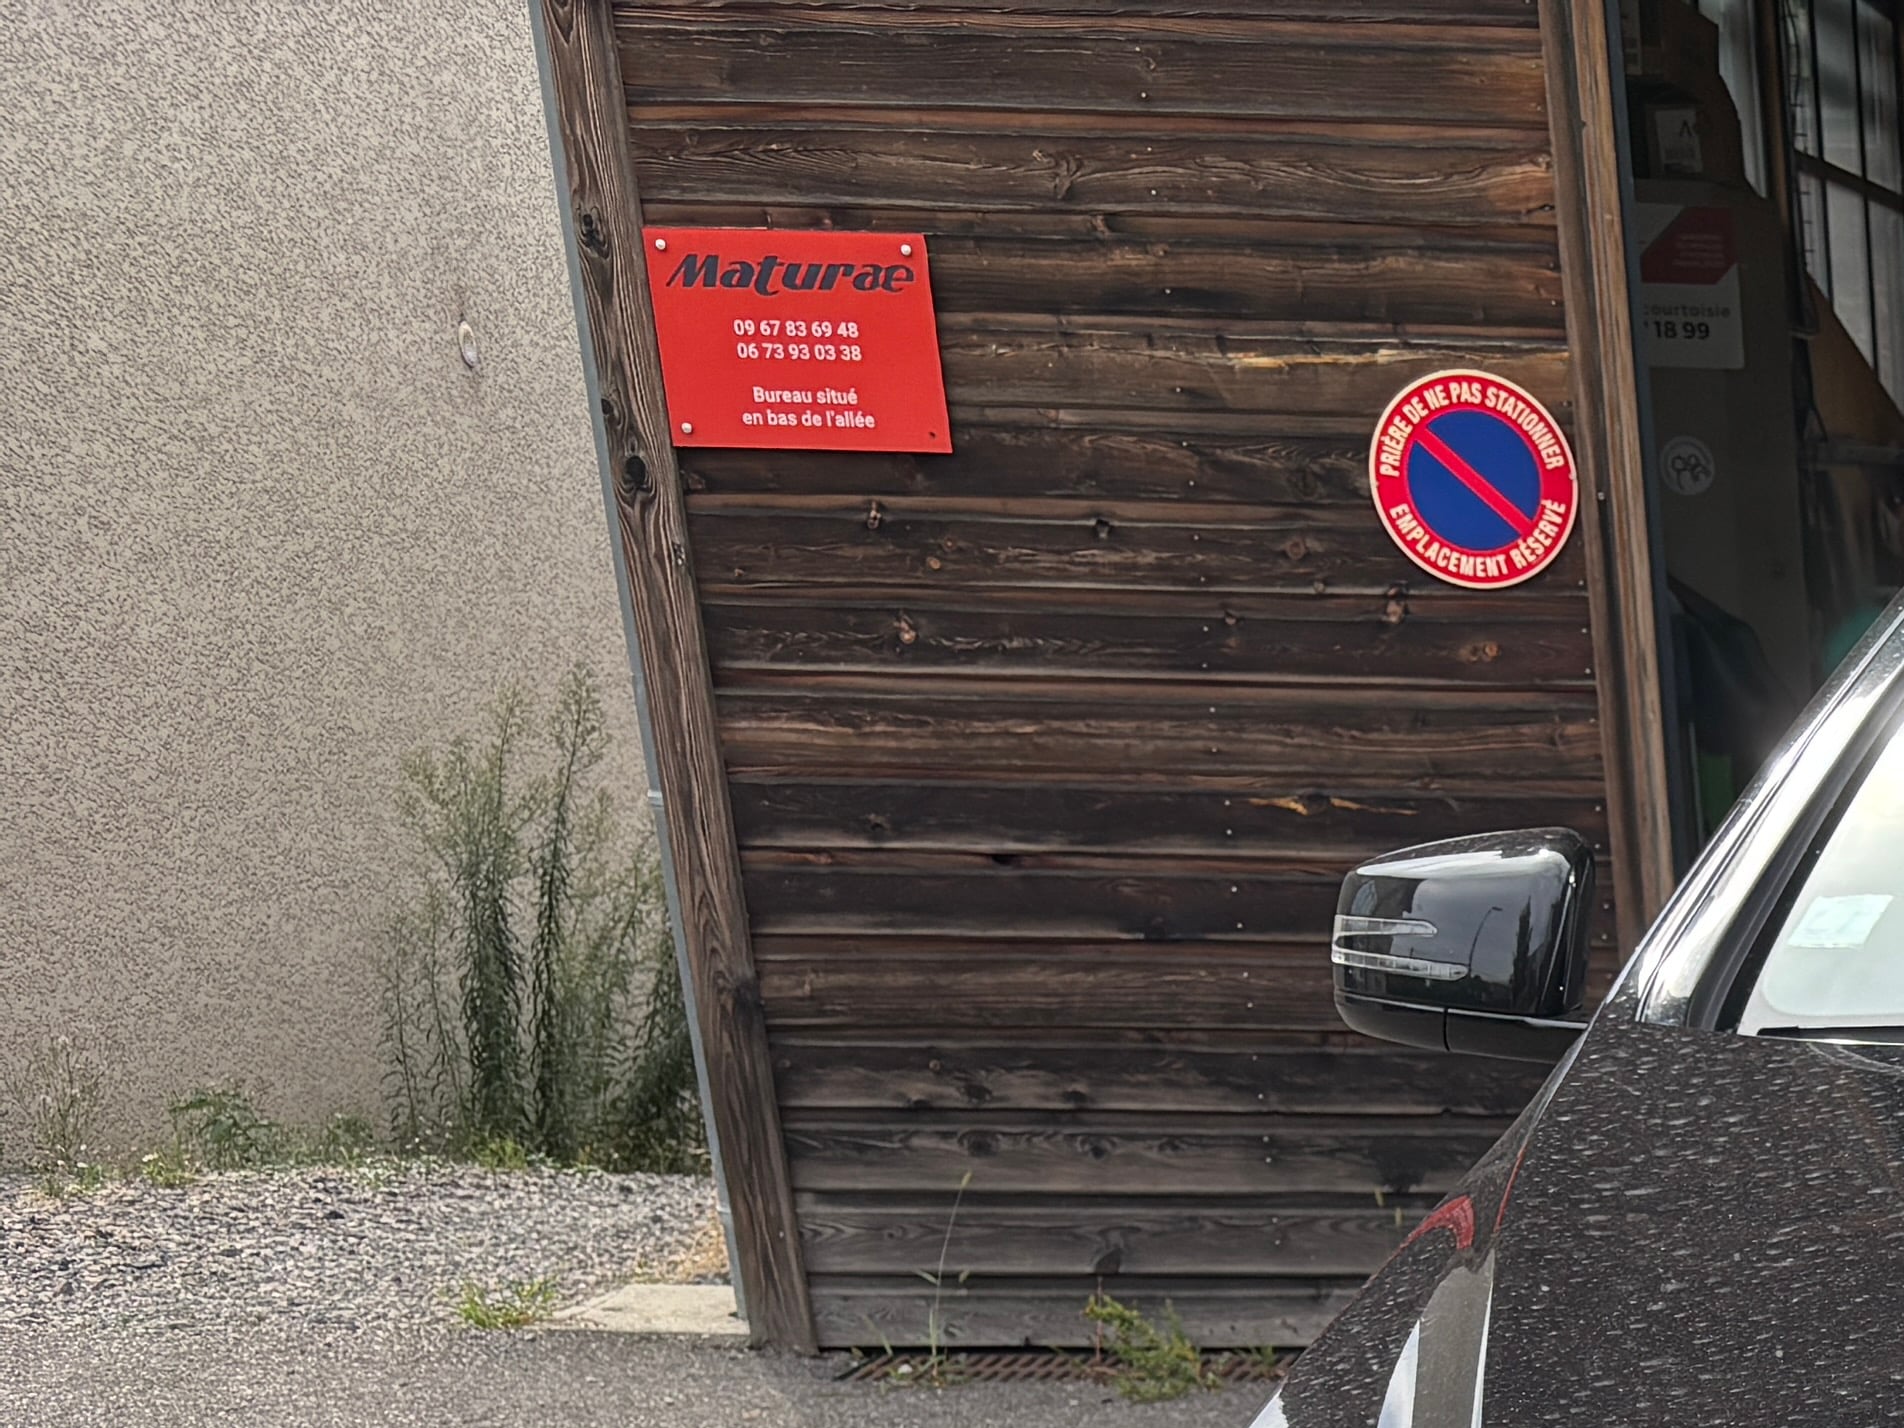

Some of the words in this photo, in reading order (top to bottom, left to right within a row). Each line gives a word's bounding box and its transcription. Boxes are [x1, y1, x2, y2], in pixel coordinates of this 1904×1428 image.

[666, 253, 915, 297] Maturae
[733, 319, 756, 336] 09
[759, 320, 781, 336] 67
[785, 320, 808, 337] 83
[811, 321, 833, 338] 69
[837, 322, 859, 338] 48
[1653, 321, 1678, 338] 18
[1682, 321, 1710, 340] 99
[737, 342, 759, 359] 06
[762, 343, 785, 359] 73
[788, 343, 810, 360] 93
[814, 344, 836, 361] 03
[840, 345, 862, 361] 38
[752, 386, 813, 404] Bureau
[817, 387, 859, 405] situé
[742, 412, 764, 426] en
[766, 408, 798, 426] bas
[801, 409, 822, 427] de
[825, 410, 876, 428] l'allée
[1379, 415, 1413, 477] PRIÈRE
[1402, 398, 1429, 425] DE
[1423, 385, 1450, 410] NE
[1448, 381, 1483, 404] PAS
[1484, 386, 1566, 470] STATIONNER
[1389, 503, 1509, 577] EMPLACEMENT
[1509, 498, 1567, 570] RÉSERVÉ
